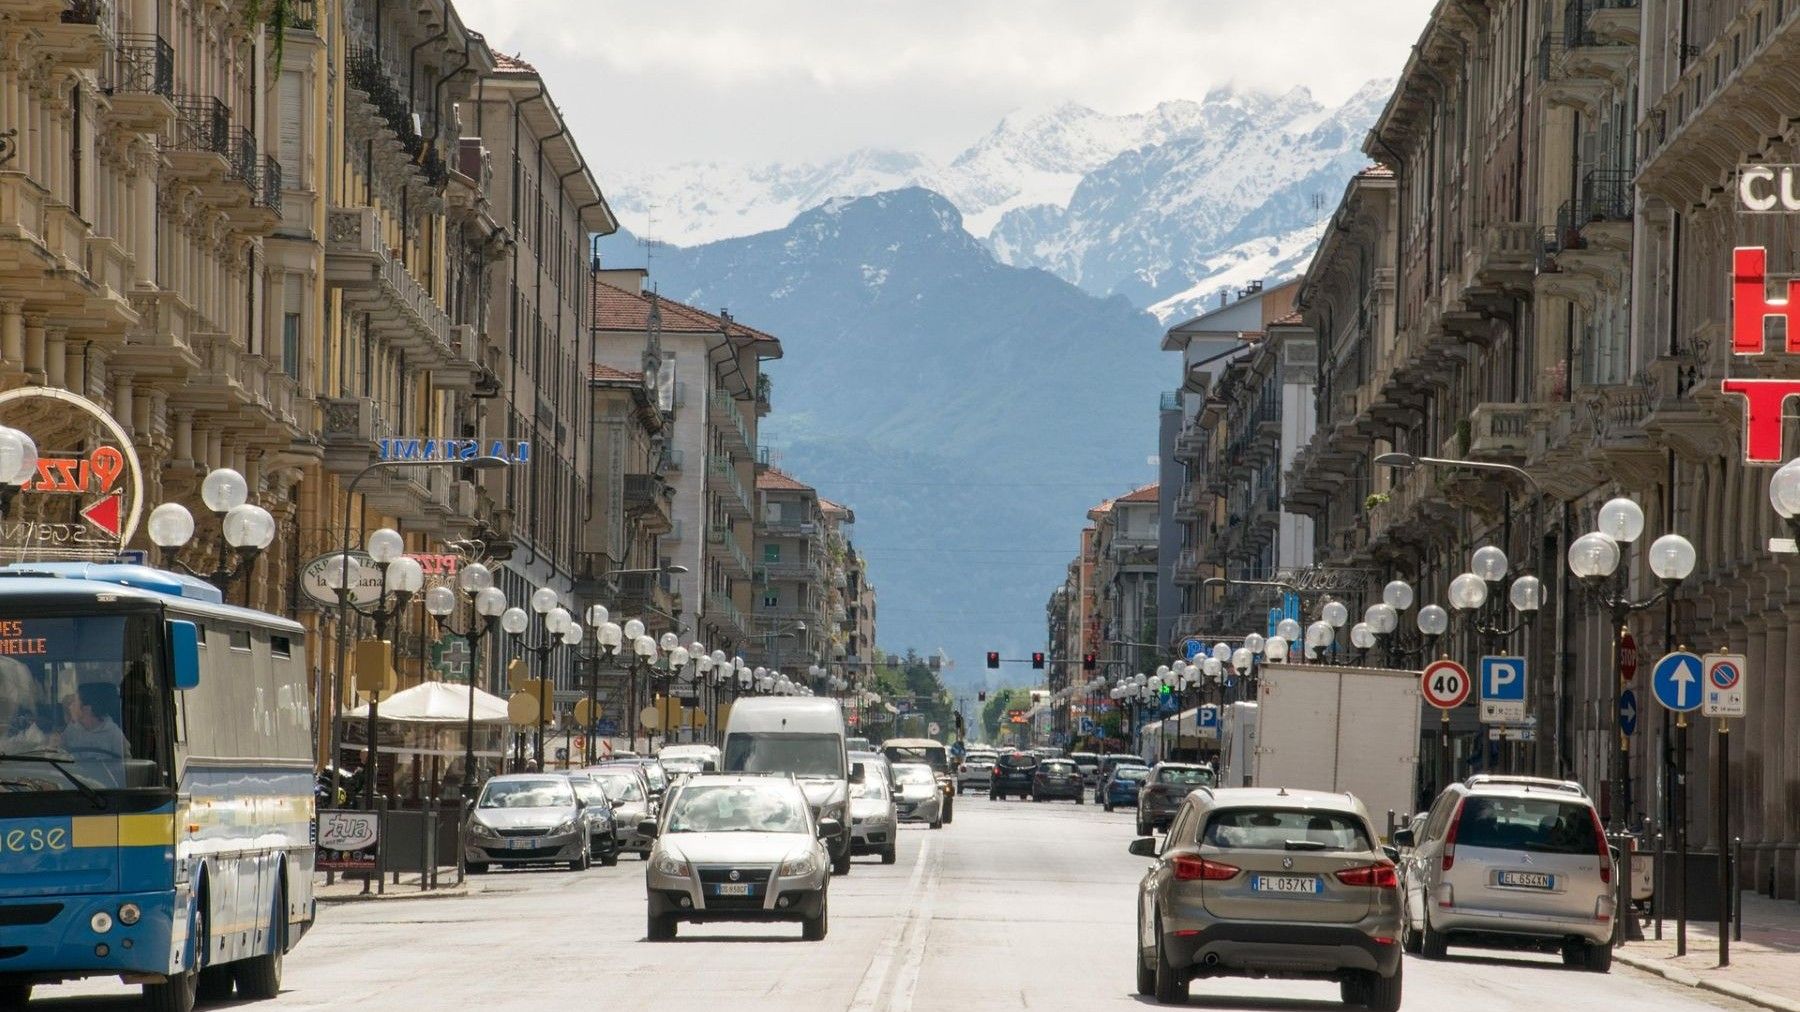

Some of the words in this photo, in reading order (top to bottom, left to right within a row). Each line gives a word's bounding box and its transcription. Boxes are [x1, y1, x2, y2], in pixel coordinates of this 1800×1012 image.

[1433, 676, 1459, 694] 40
[1490, 663, 1516, 695] P
[1200, 709, 1213, 725] P
[0, 828, 66, 852] ese
